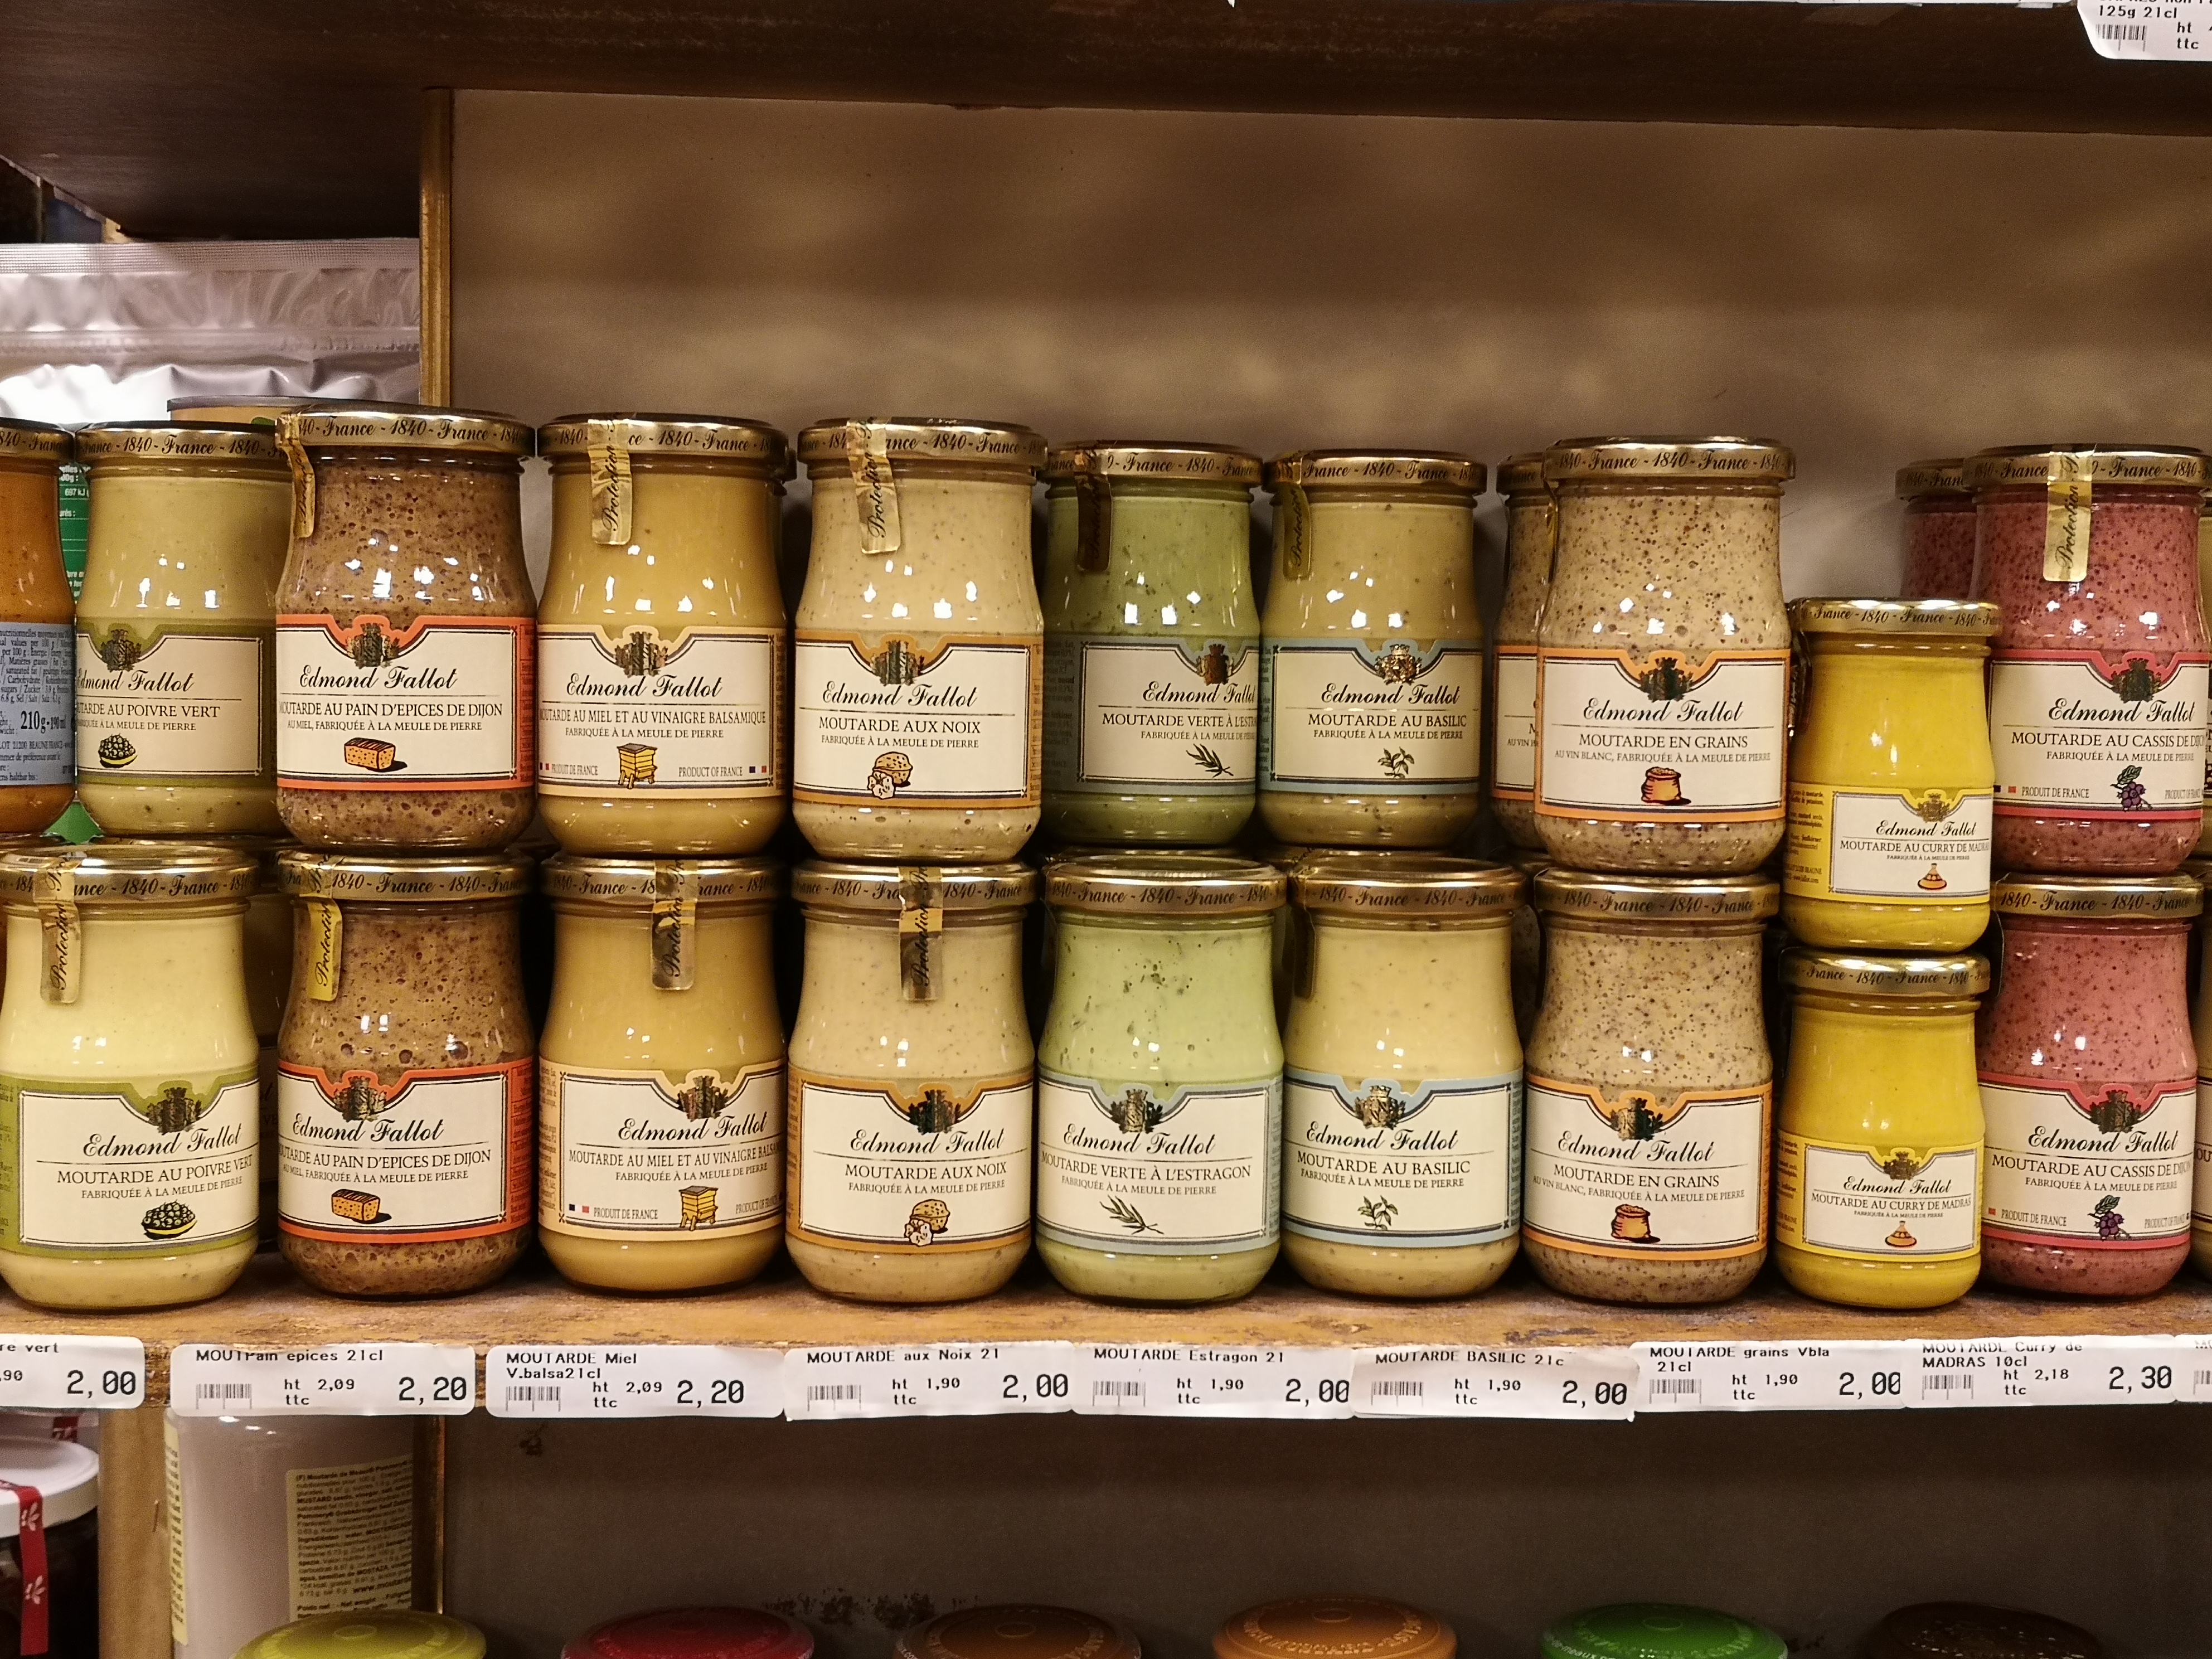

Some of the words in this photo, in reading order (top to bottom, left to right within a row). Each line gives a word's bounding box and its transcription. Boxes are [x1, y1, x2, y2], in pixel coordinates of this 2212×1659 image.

[2100, 5, 2136, 18] 125g
[2143, 7, 2177, 18] 21cl
[2177, 22, 2192, 33] ht
[2177, 38, 2199, 49] ttc
[322, 418, 376, 436] France
[390, 419, 426, 435] 1840
[300, 664, 379, 688] Edmond
[385, 666, 458, 689] Fallot
[822, 681, 904, 705] Edmond
[908, 683, 978, 707] Fallot
[108, 705, 124, 715] AU
[128, 705, 177, 716] POIVRE
[181, 706, 220, 717] VERT
[325, 704, 342, 715] AU
[346, 704, 378, 716] PAIN
[382, 704, 443, 716] D'EPICES
[448, 705, 465, 716] DE
[468, 704, 502, 719] DIJON
[1583, 698, 1671, 721] Edmond
[1677, 700, 1743, 721] Fallot
[2049, 698, 2142, 721] Edmond
[2146, 700, 2196, 722] Fallot
[574, 711, 585, 722] AU
[588, 711, 612, 722] MIEL
[615, 711, 628, 722] ET
[632, 712, 648, 723] AU
[652, 712, 706, 724] VINAIGRE
[709, 711, 766, 725] BALSAMIQUE
[819, 717, 899, 732] MOUTARDE
[903, 720, 938, 733] AUX
[942, 721, 981, 733] NOIX
[1102, 713, 1183, 726] MOUTARDE
[1187, 716, 1224, 727] VERTE
[1226, 713, 1233, 727] À
[1308, 714, 1396, 726] MOUTARDE
[1401, 715, 1422, 726] AU
[1426, 715, 1467, 727] BASILIC
[821, 735, 865, 745] FABRIQUÉE
[867, 735, 875, 745] À
[877, 737, 889, 745] LA
[892, 739, 927, 747] MEULE
[947, 739, 978, 748] PIERRE
[1579, 734, 1665, 748] MOUTARDE
[1670, 736, 1691, 748] EN
[1695, 736, 1748, 749] GRAINS
[2011, 732, 2102, 746] MOUTARDE
[2105, 735, 2129, 747] AU
[2132, 735, 2174, 748] CASSIS
[2176, 735, 2188, 747] DE
[2022, 787, 2050, 797] PRODUIT
[2051, 788, 2060, 798] DE
[2063, 788, 2089, 798] FRANCE
[1840, 840, 1901, 852] MOUTARDE
[1904, 842, 1919, 852] AU
[1922, 843, 1954, 853] CURRY
[1956, 843, 1967, 852] DE
[84, 1133, 182, 1156] Edmond
[187, 1123, 242, 1152] Fallot
[1064, 1123, 1142, 1152] Edmond
[1147, 1132, 1216, 1154] Fallot
[313, 1155, 330, 1167] AU
[333, 1156, 363, 1168] PAIN
[367, 1155, 429, 1168] D'EPICES
[432, 1154, 451, 1167] DE
[454, 1149, 492, 1167] DIJON
[569, 1150, 624, 1166] MOUTARDE
[627, 1156, 643, 1166] AU
[647, 1156, 674, 1167] MIEL
[677, 1154, 691, 1166] ET
[695, 1153, 710, 1166] AU
[714, 1149, 756, 1165] VINAIGRE
[1297, 1151, 1377, 1173] MOUTARDE
[1382, 1162, 1407, 1175] AU
[1412, 1161, 1471, 1175] BASILIC
[57, 1170, 154, 1184] MOUTARDE
[158, 1169, 182, 1182] AU
[186, 1163, 231, 1180] POIVRE
[234, 1154, 253, 1172] VERT
[845, 1164, 937, 1179] MOUTARDE
[941, 1166, 973, 1179] AUX
[977, 1162, 1007, 1177] NOIX
[1041, 1151, 1098, 1175] MOUTARDE
[1101, 1165, 1147, 1180] VERTE
[1151, 1166, 1161, 1181] À
[1166, 1165, 1251, 1181] L'ESTRAGON
[1992, 1155, 2079, 1175] MOUTARDE
[2083, 1165, 2106, 1176] AU
[2111, 1166, 2155, 1177] CASSIS
[2157, 1165, 2171, 1176] DE
[1554, 1165, 1634, 1186] MOUTARDE
[1638, 1175, 1660, 1187] EN
[1665, 1175, 1720, 1187] GRAINS
[1812, 1193, 1868, 1208] MOUTARDE
[1871, 1200, 1887, 1209] AU
[1889, 1201, 1925, 1210] CURRY
[1928, 1200, 1939, 1210] DE
[1942, 1197, 1971, 1209] MADRAS
[1650, 1347, 1735, 1357] MOUTARDE
[1744, 1348, 1788, 1359] grains
[1798, 1348, 1829, 1357] Vbla
[2016, 1342, 2055, 1354] Curry
[2066, 1342, 2082, 1351] de
[287, 1350, 338, 1362] epices
[347, 1350, 382, 1361] 21cl
[507, 1354, 596, 1364] MOUTARDE
[607, 1354, 637, 1364] Miel
[807, 1350, 895, 1363] MOUTARDE
[904, 1352, 930, 1361] aux
[939, 1350, 971, 1360] Noix
[1094, 1348, 1181, 1360] MOUTARDE
[1190, 1350, 1258, 1365] Estragon
[1375, 1351, 1459, 1365] MOUTARDE
[1467, 1351, 1525, 1364] BASILIC
[1535, 1354, 1564, 1366] 21c
[1923, 1357, 1985, 1367] MADRAS
[1996, 1356, 2027, 1366] 10cl
[507, 1368, 601, 1379] V.balsa21cl
[1658, 1362, 1692, 1372] 21cl
[1733, 1375, 1747, 1385] ht
[1765, 1375, 1797, 1386] 1,90
[2004, 1369, 2018, 1380] ht
[2035, 1369, 2069, 1381] 2,18
[2109, 1366, 2172, 1394] 2,30
[67, 1370, 136, 1397] 2,00
[284, 1379, 300, 1390] ht
[318, 1379, 355, 1391] 2,09
[399, 1376, 466, 1405] 2,20
[593, 1382, 609, 1393] ht
[626, 1382, 662, 1394] 2,09
[892, 1379, 908, 1390] ht
[928, 1378, 960, 1390] 1,90
[1003, 1374, 1068, 1403] 2,00
[1177, 1379, 1192, 1389] ht
[1211, 1379, 1244, 1391] 1,90
[1454, 1380, 1469, 1390] ht
[1488, 1379, 1521, 1391] 1,90
[1839, 1372, 1901, 1399] 2,00
[2004, 1384, 2026, 1395] ttc
[286, 1395, 309, 1405] ttc
[677, 1380, 744, 1408] 2,20
[894, 1394, 917, 1405] ttc
[1177, 1394, 1201, 1405] ttc
[1286, 1379, 1349, 1407] 2,00
[1455, 1394, 1478, 1405] ttc
[1563, 1380, 1627, 1408] 2,00
[1734, 1390, 1755, 1400] ttc
[594, 1398, 618, 1408] ttc
